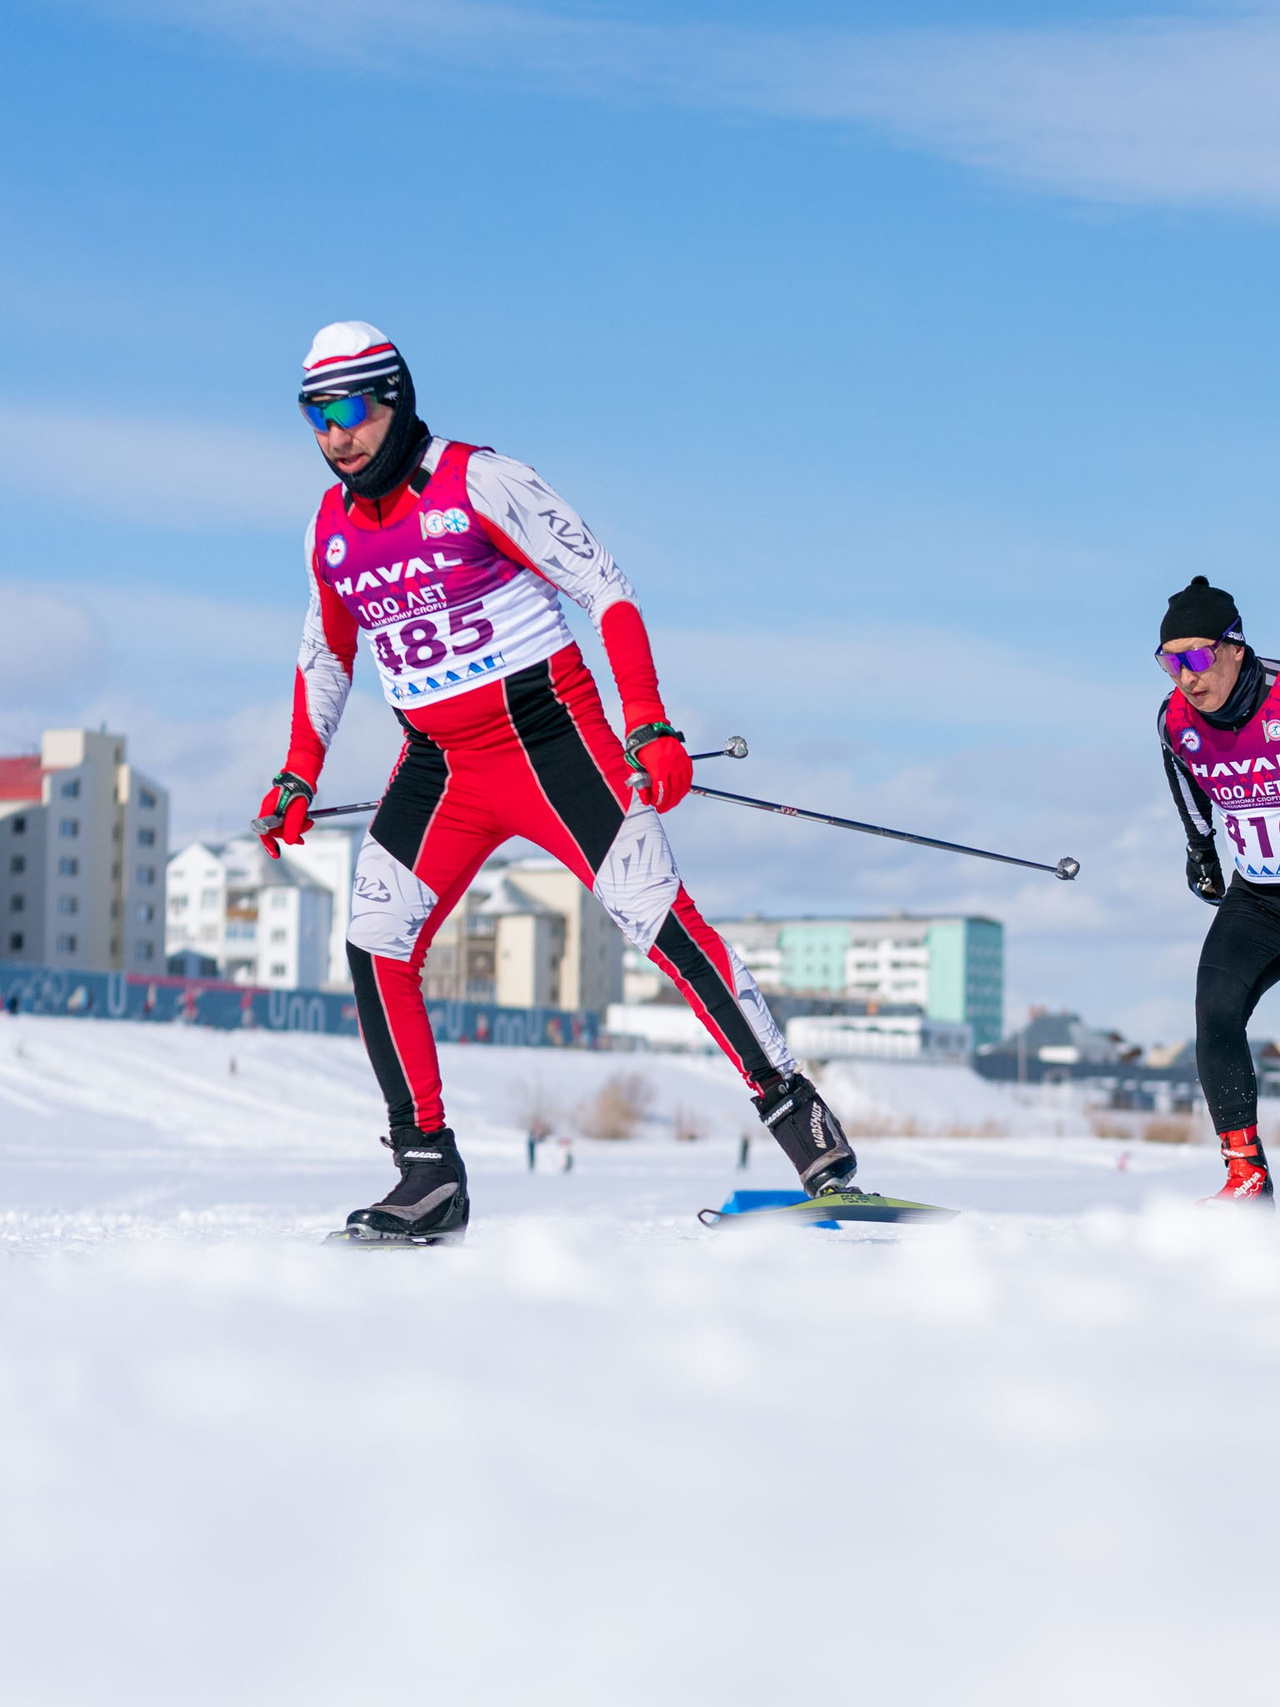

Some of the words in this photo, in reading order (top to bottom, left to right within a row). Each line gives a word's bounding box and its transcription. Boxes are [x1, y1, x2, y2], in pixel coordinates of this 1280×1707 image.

[334, 552, 464, 597] HAVAL
[358, 597, 400, 622] 100
[407, 583, 448, 609] ЛЕТ
[375, 600, 494, 676] 485
[1212, 785, 1246, 801] 100
[810, 1101, 827, 1149] MADSHUS
[1233, 1171, 1261, 1199] alpina
